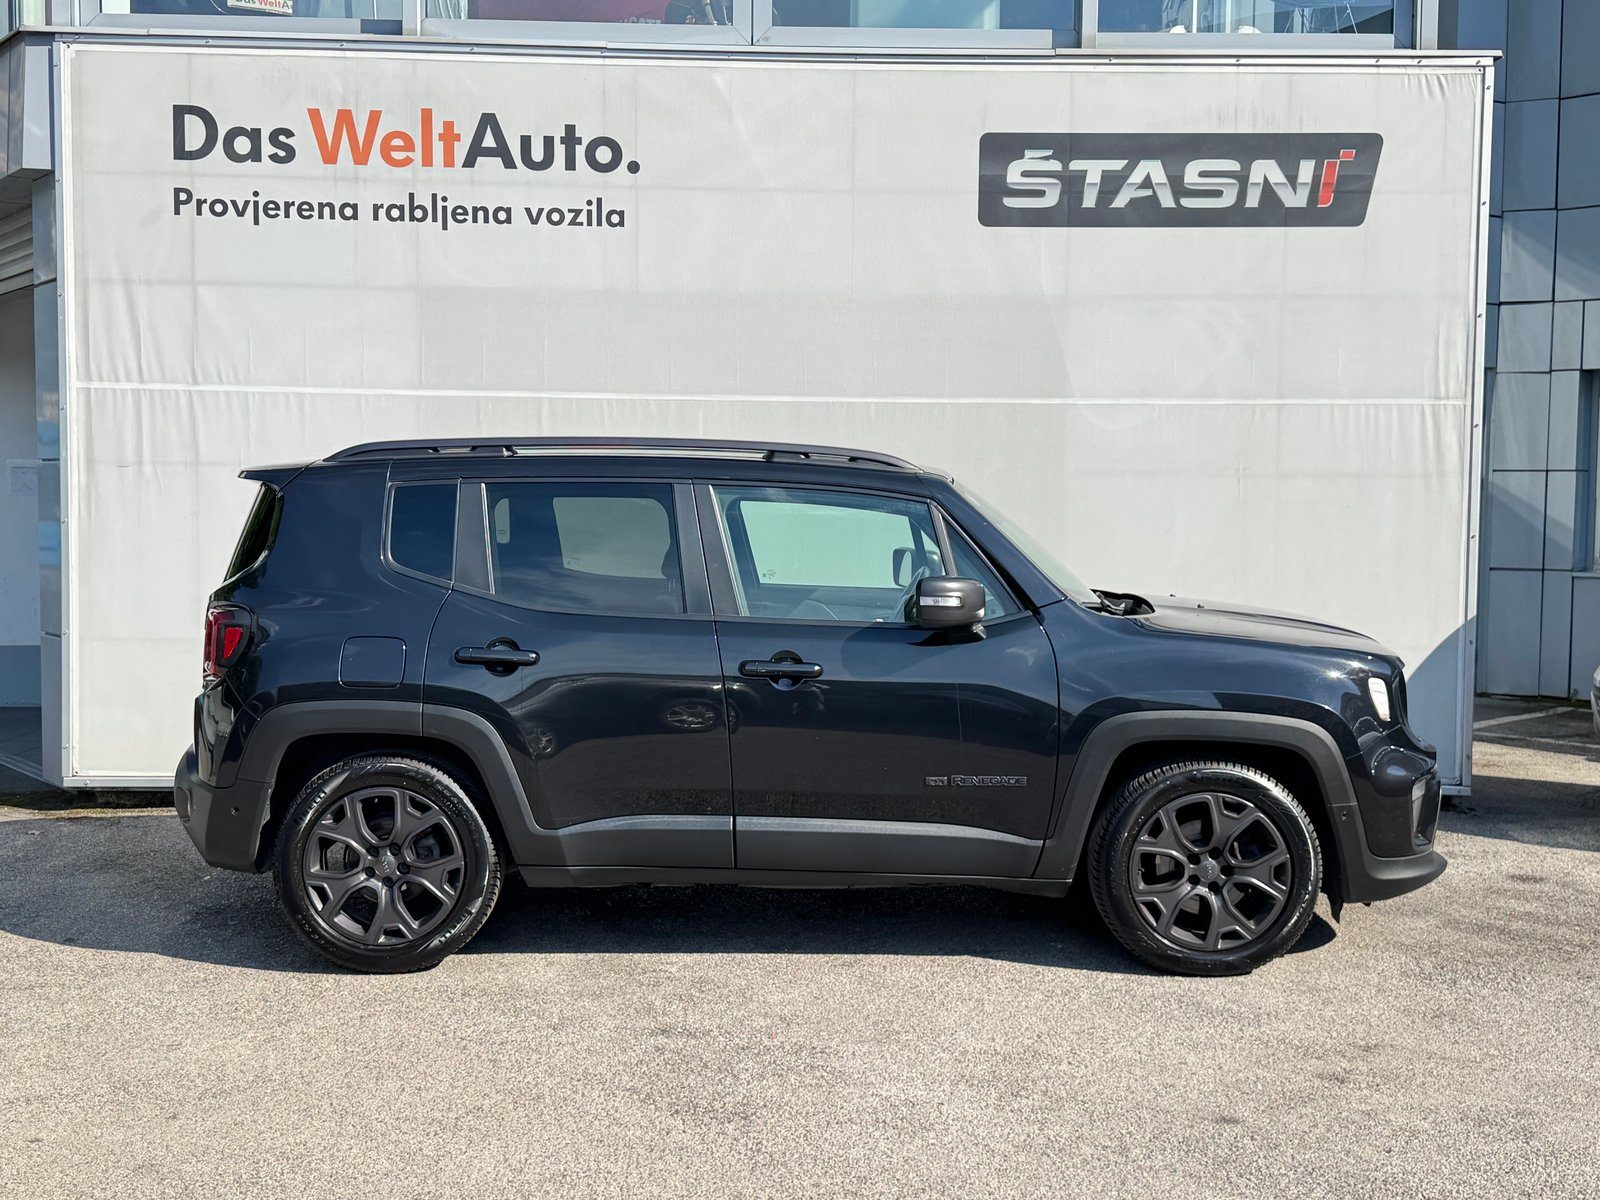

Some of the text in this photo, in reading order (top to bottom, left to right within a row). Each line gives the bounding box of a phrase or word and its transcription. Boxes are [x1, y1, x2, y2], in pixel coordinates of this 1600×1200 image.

[173, 105, 640, 174] Das WeltAuto.
[174, 188, 624, 230] Provjerena rabljena vozila
[951, 775, 1027, 787] RENEGADE
